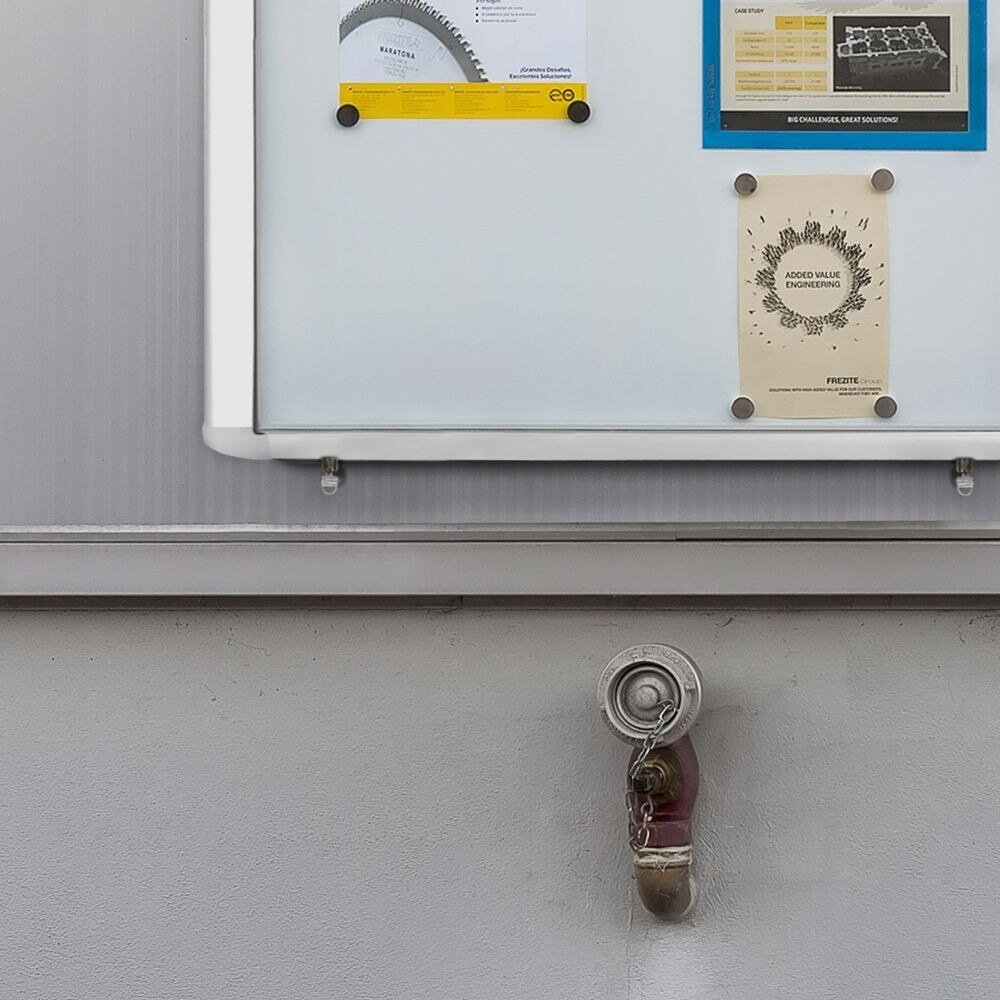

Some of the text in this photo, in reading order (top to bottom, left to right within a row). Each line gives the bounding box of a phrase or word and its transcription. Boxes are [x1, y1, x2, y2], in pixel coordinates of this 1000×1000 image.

[379, 46, 416, 60] MARATONA
[799, 116, 840, 124] CHALLENGES,
[785, 271, 814, 279] ADDED
[785, 281, 841, 289] ENGINEERING
